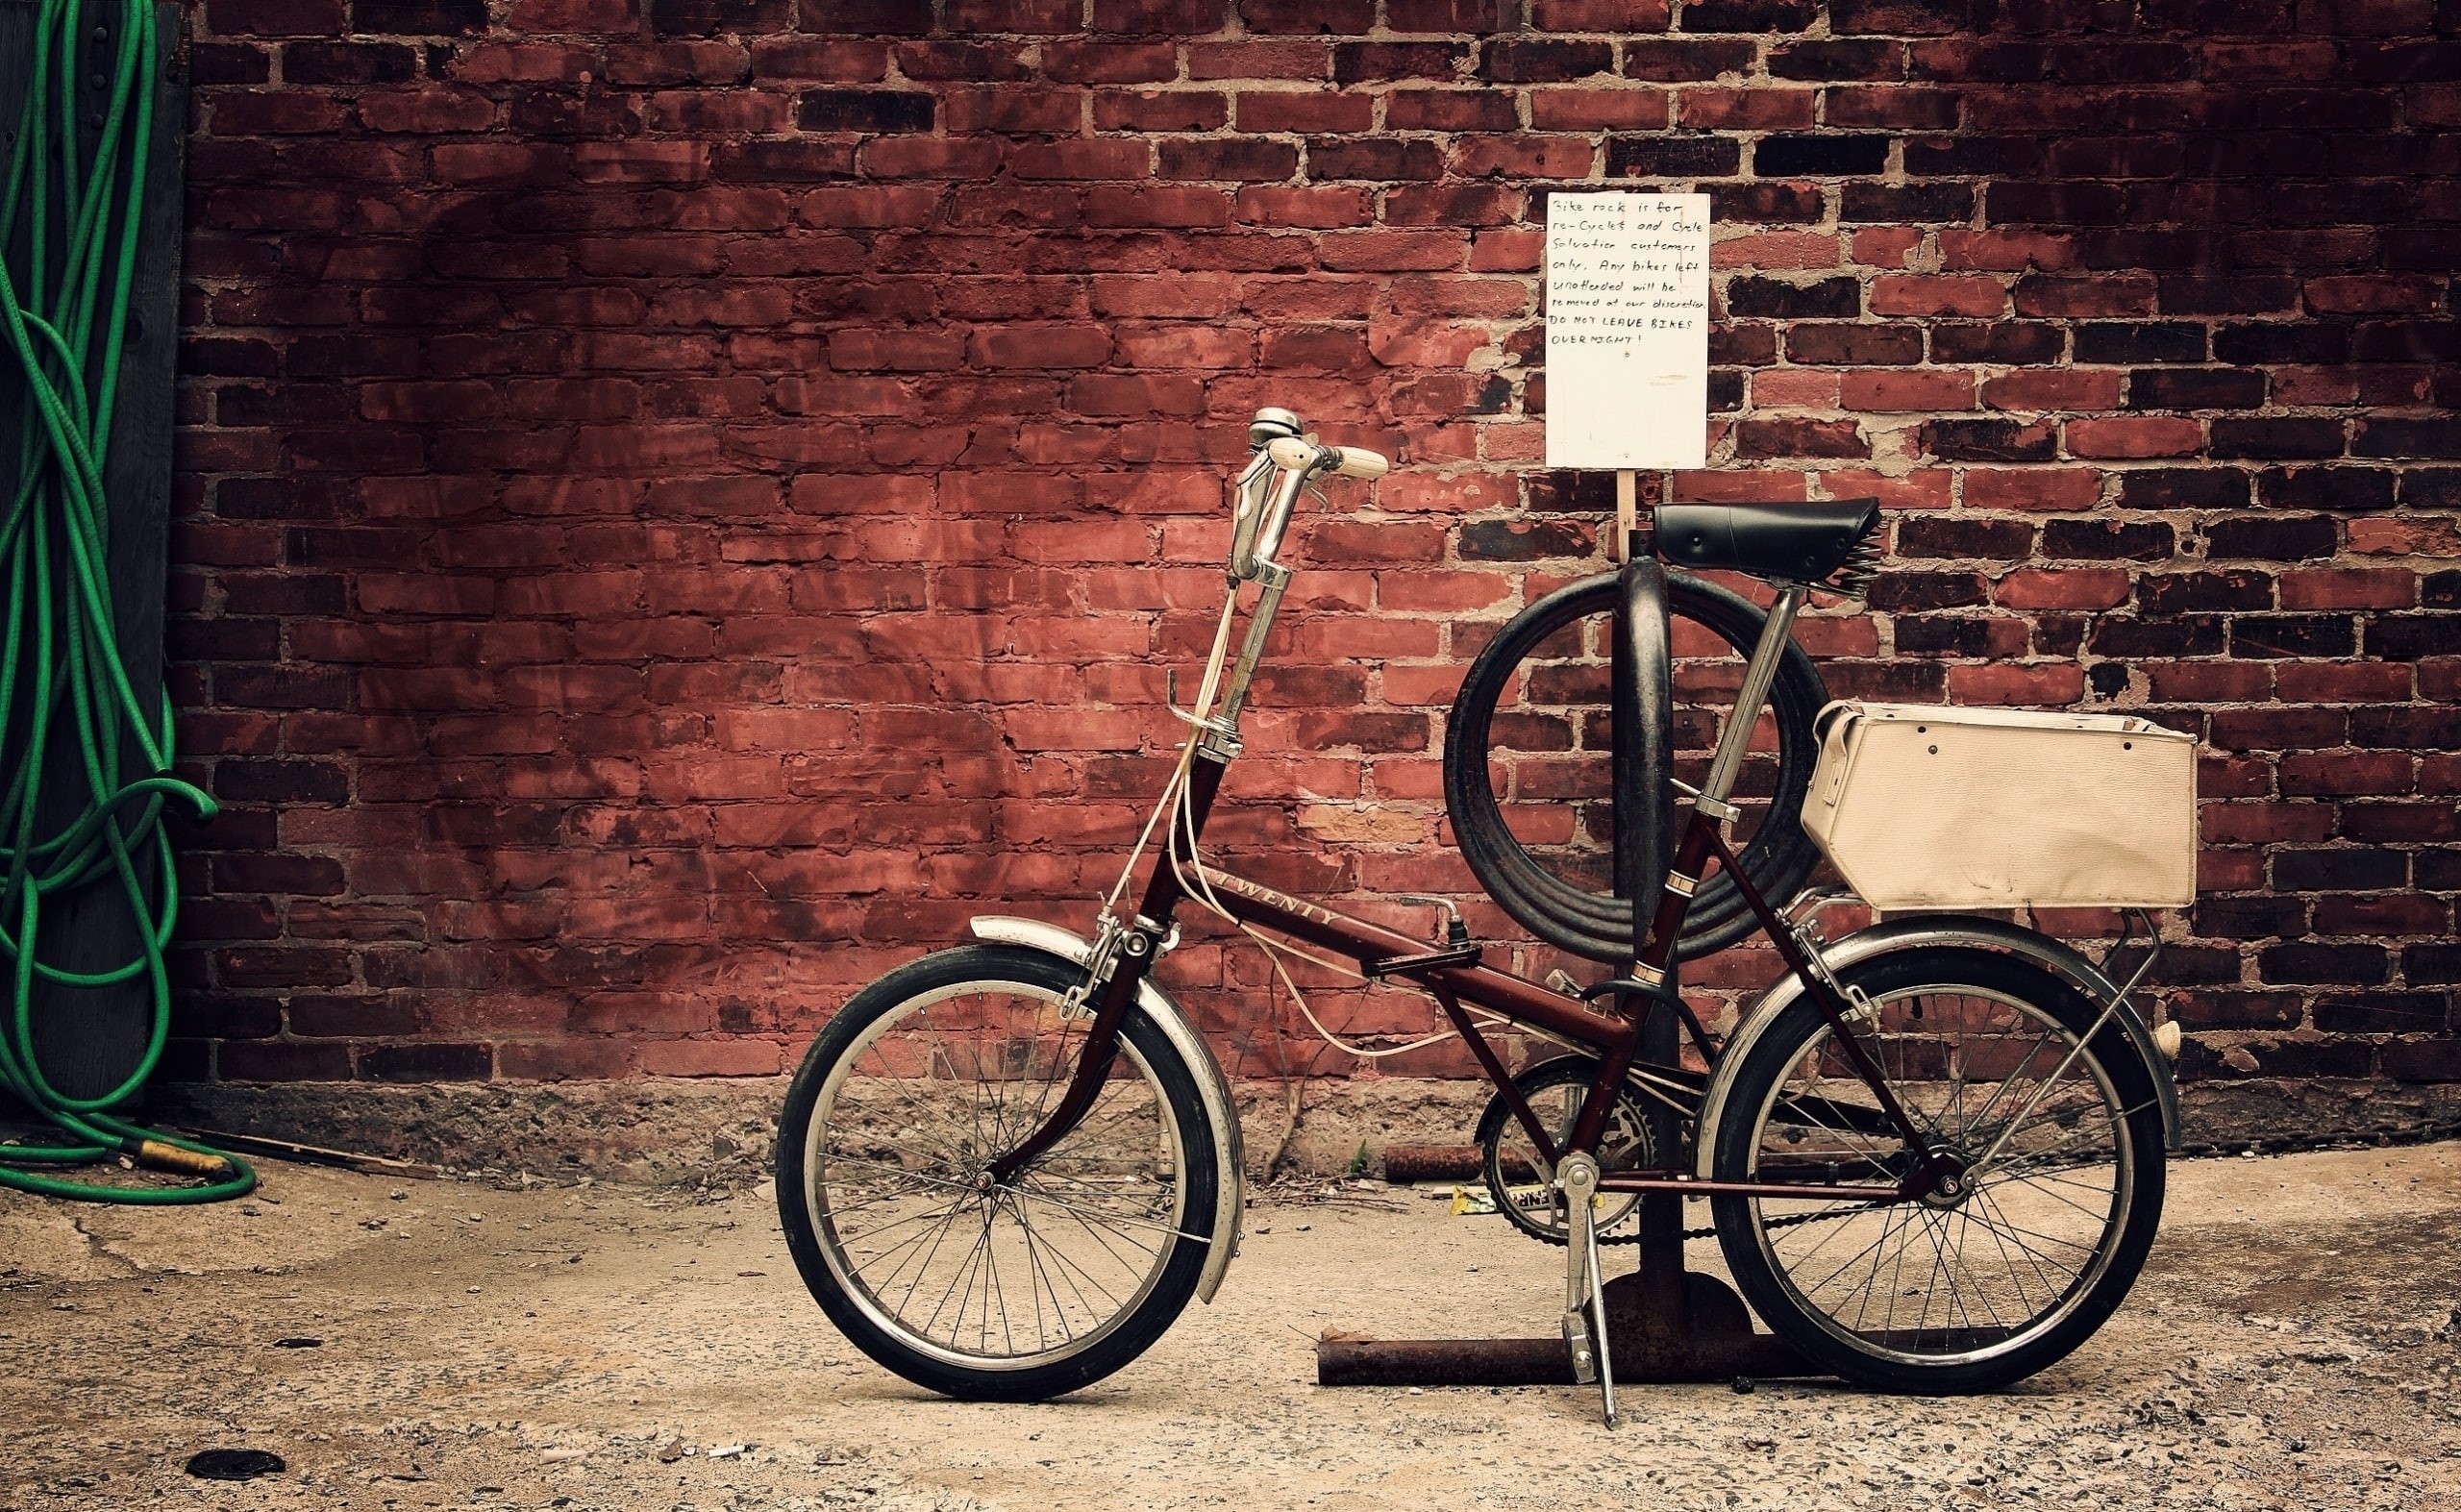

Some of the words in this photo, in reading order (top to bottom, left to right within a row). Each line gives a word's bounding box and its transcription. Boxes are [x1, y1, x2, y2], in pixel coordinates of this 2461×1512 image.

[1656, 203, 1682, 212] for
[1637, 222, 1662, 231] and
[1672, 222, 1703, 234] Cycle
[1631, 240, 1696, 251] customers
[1600, 260, 1625, 273] Any
[1632, 261, 1667, 271] bikes
[1676, 262, 1700, 273] left
[1633, 283, 1654, 291] will
[1662, 282, 1676, 291] be
[1549, 315, 1566, 324] DO
[1603, 317, 1642, 328] LEAVE
[1652, 320, 1692, 329] BIKES
[1216, 872, 1343, 926] TWENTY
